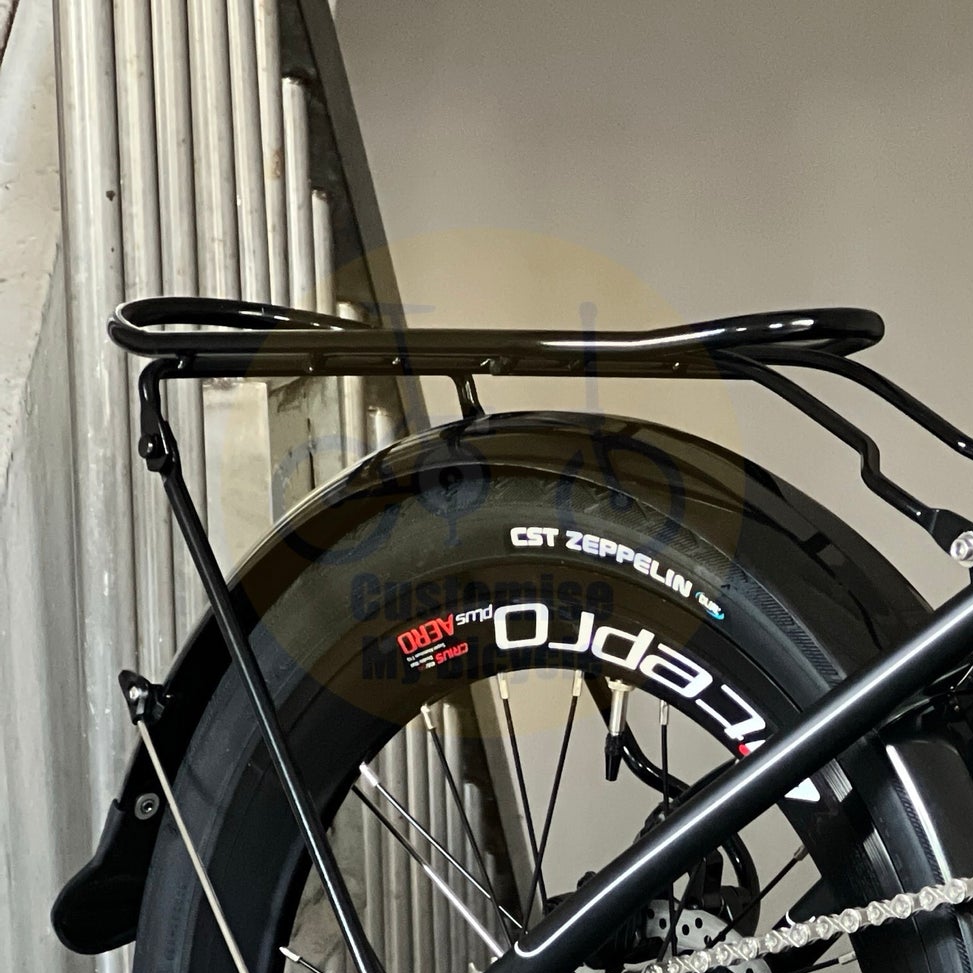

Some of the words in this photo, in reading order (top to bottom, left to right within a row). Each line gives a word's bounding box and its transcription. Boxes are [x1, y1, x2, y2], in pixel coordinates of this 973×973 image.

[510, 527, 559, 547] CST
[565, 530, 693, 598] ZEPPELIN
[397, 613, 454, 655] AERO
[455, 603, 493, 626] plus
